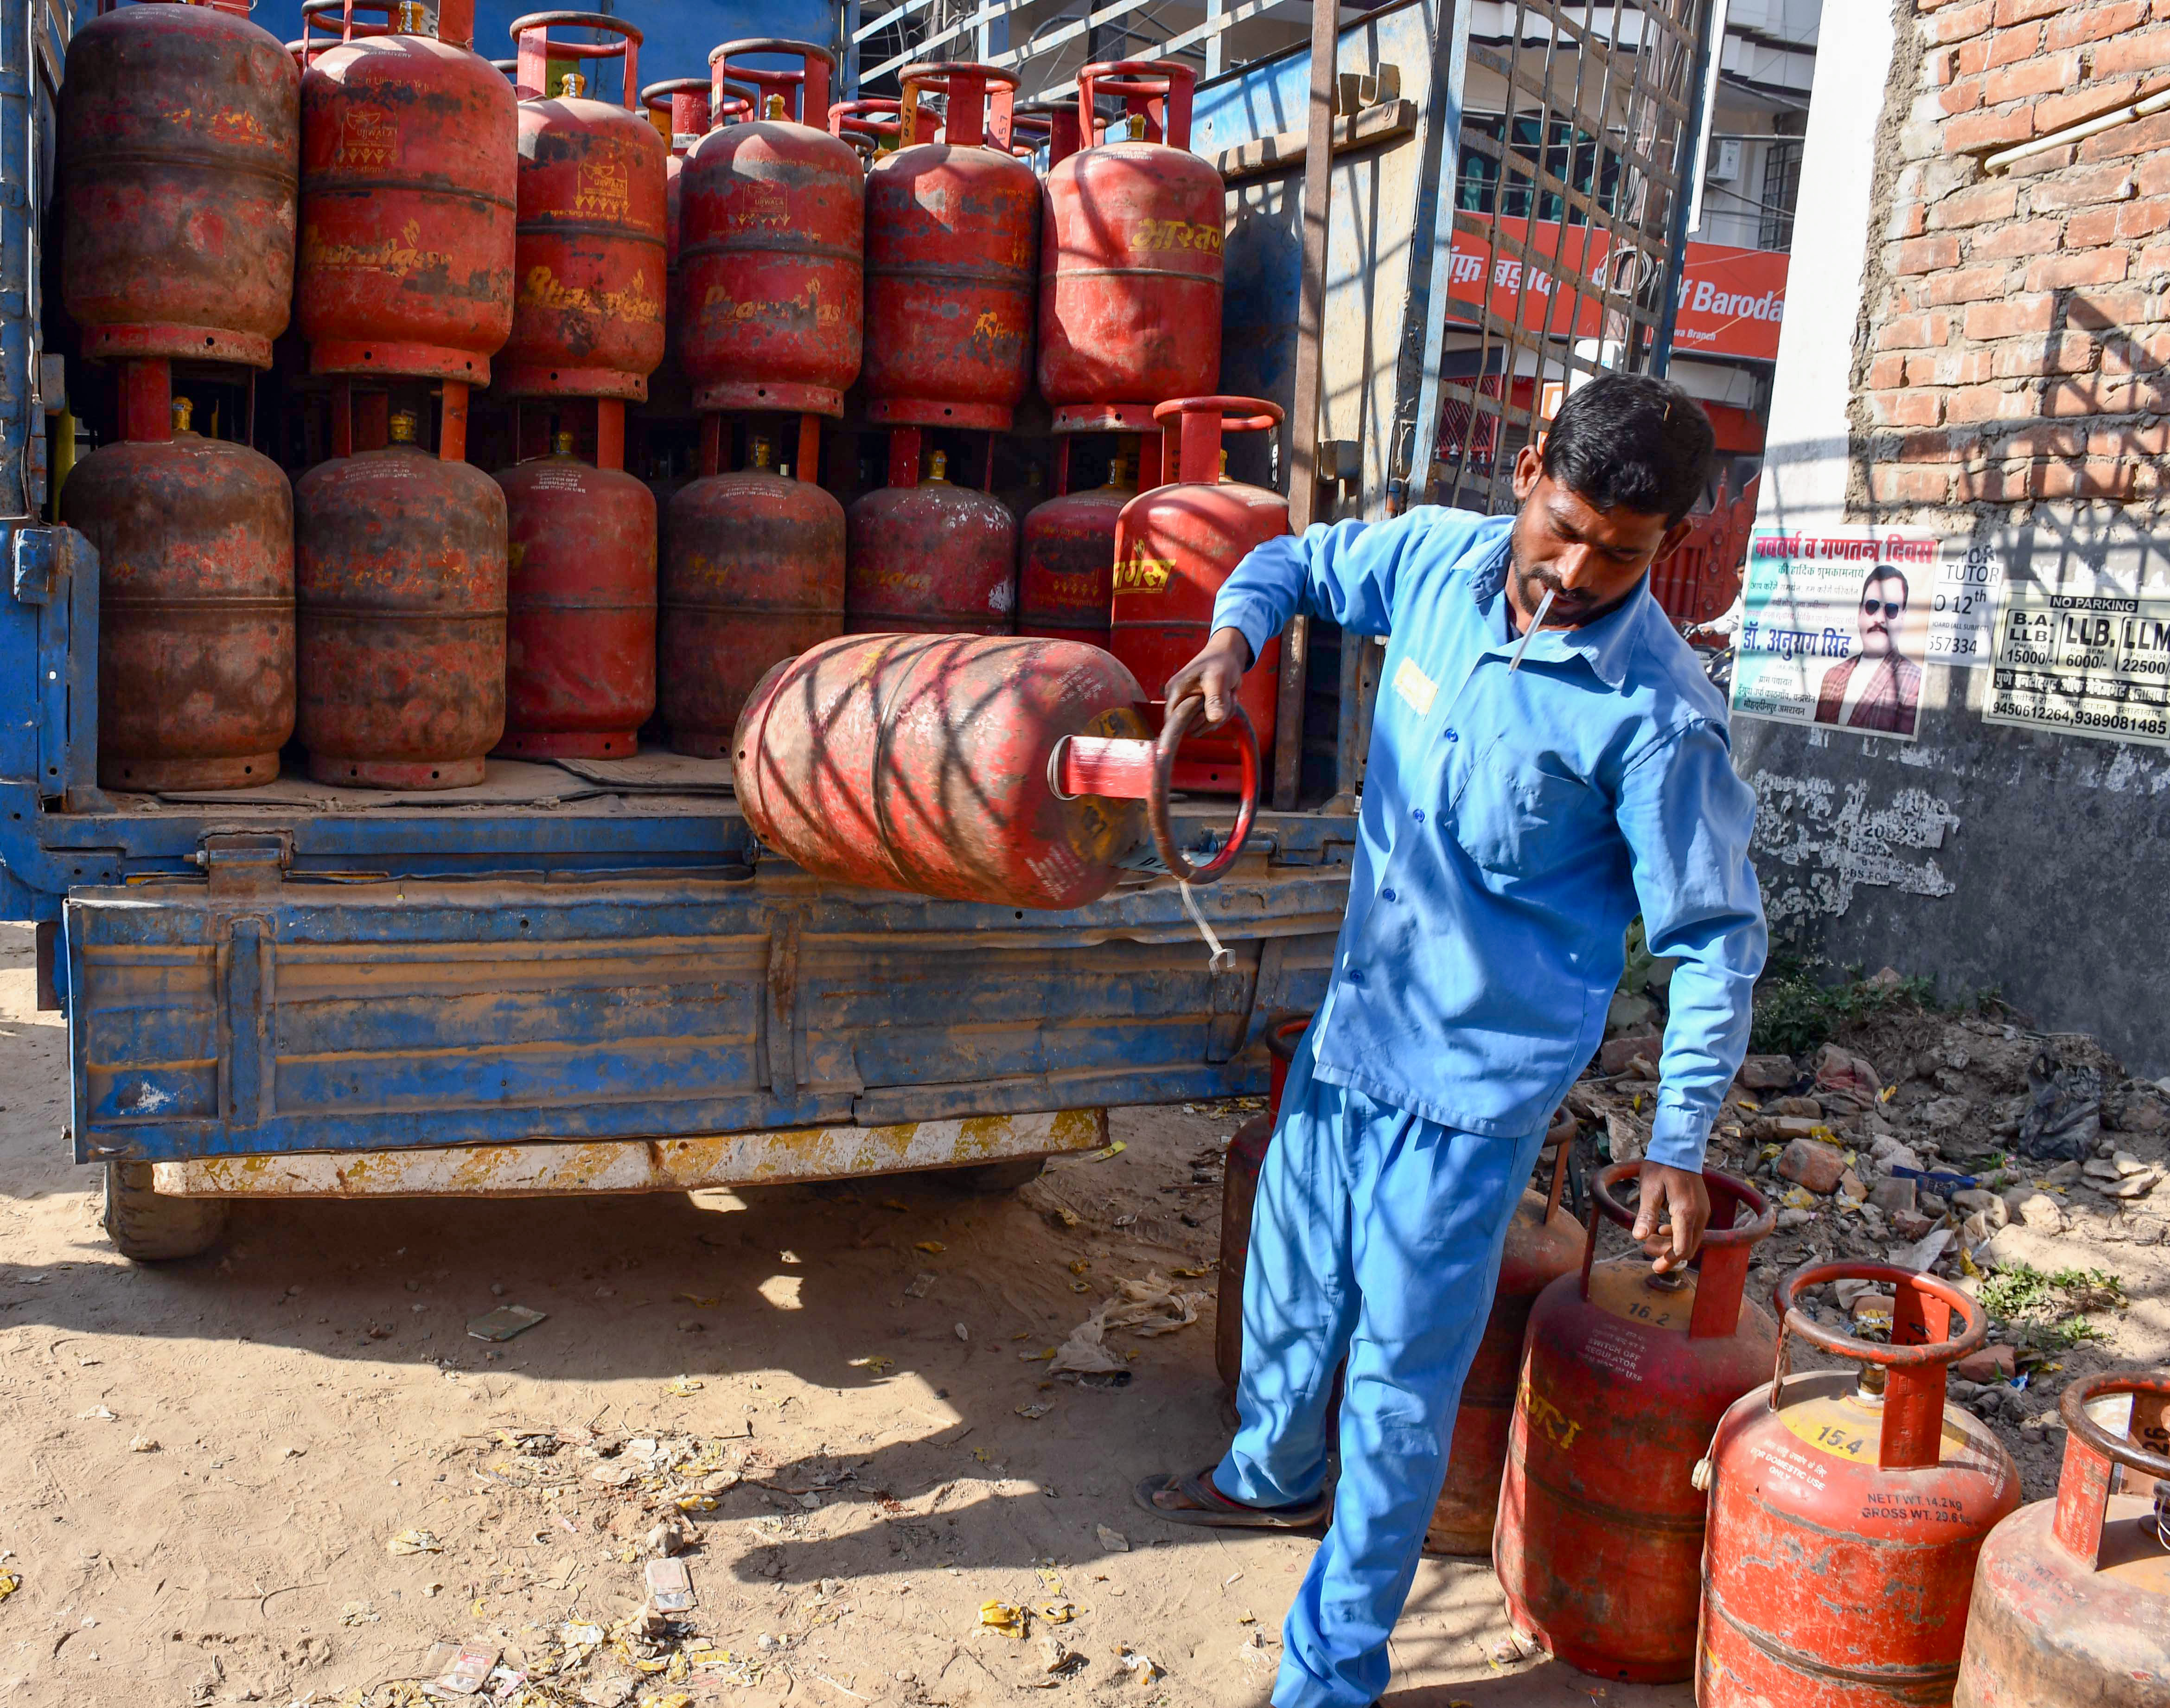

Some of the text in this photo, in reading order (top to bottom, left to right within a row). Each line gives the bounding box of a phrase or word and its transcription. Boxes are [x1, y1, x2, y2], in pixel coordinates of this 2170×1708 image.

[1692, 281, 1784, 322] Baroda
[1687, 328, 1716, 341] Branch
[1755, 531, 1802, 559] नववर्ष
[1804, 538, 1818, 559] व
[1885, 534, 1937, 564] दिवस
[1778, 563, 1788, 576] की
[1946, 564, 1999, 582] TUTOR
[1951, 589, 1987, 614] 12th
[2052, 596, 2136, 611] NO PARKING
[2013, 612, 2055, 627] B.A.
[2009, 627, 2054, 644] LLB.
[2065, 617, 2115, 647] LLB.
[1743, 621, 1852, 661] डॉ. अनुराग सिंह
[2007, 649, 2053, 665] 15000/-
[2066, 654, 2107, 669] 6000/-
[1995, 671, 2013, 688] पुणे
[1628, 1303, 1670, 1326] 16.2
[1584, 1345, 1637, 1370] REGULATOR
[1623, 1348, 1641, 1362] OFF
[1625, 1369, 1644, 1382] USE
[1818, 1426, 1864, 1455] 15.4
[1750, 1446, 1825, 1491] FOR DOMESTIC USE
[1768, 1466, 1792, 1481] ONLY
[1867, 1493, 1901, 1504] NETT
[1902, 1495, 1924, 1506] WT.
[1861, 1507, 1908, 1519] GROSS
[1909, 1508, 1933, 1521] WT.
